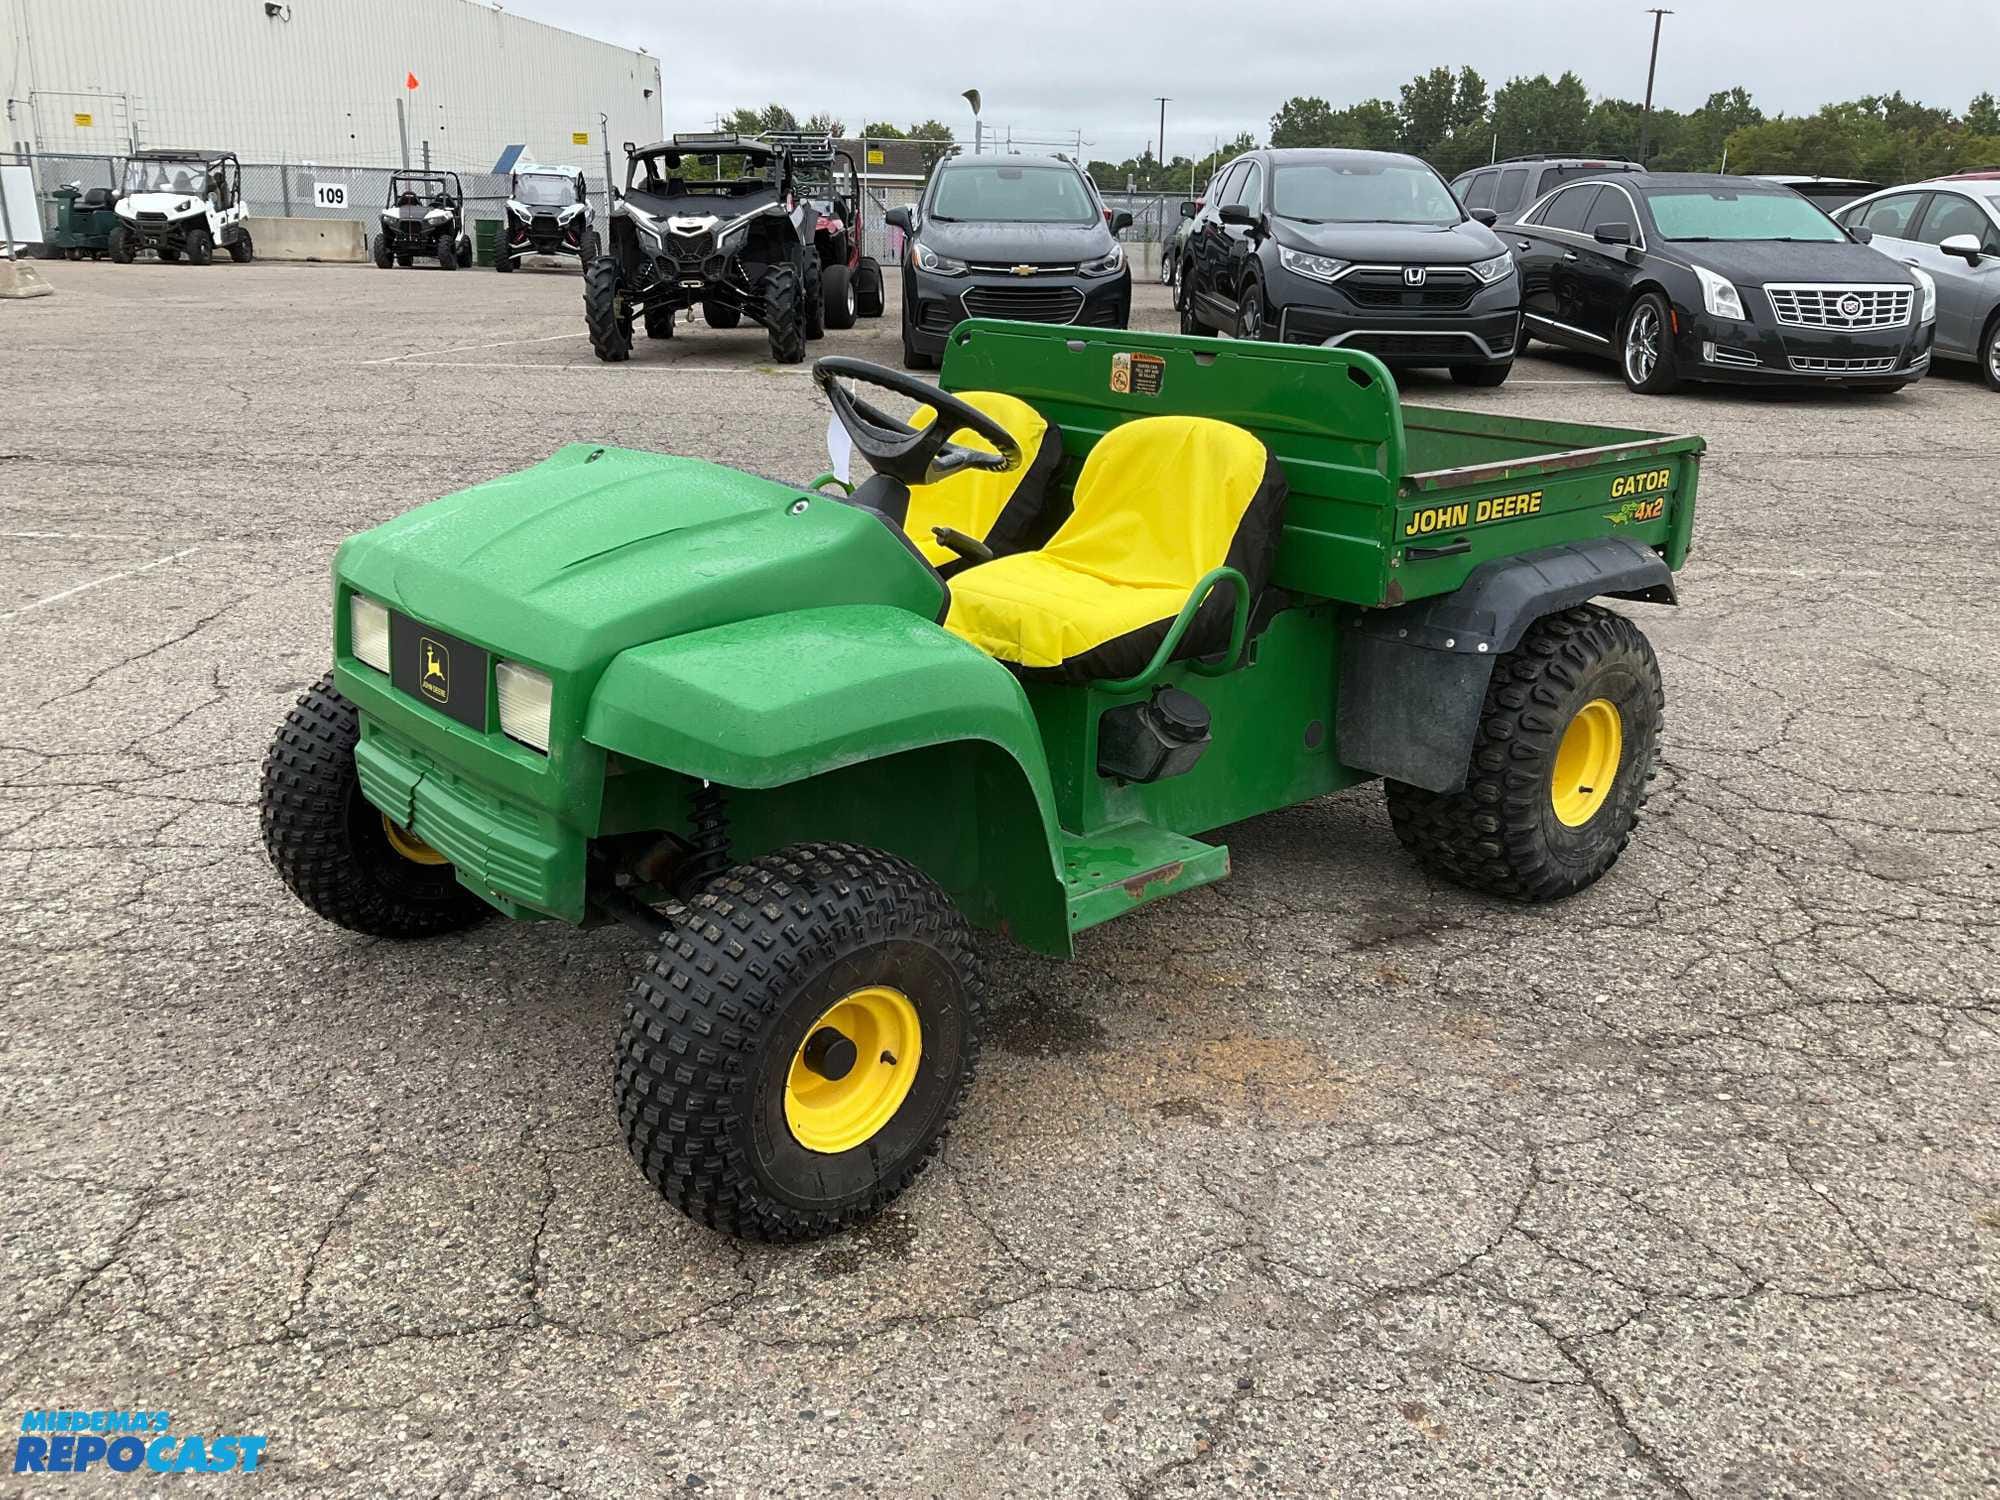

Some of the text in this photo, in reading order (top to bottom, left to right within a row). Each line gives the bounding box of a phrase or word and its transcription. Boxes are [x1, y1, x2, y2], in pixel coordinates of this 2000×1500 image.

[318, 187, 344, 204] 109
[1611, 468, 1670, 498] GATOR
[1405, 491, 1543, 536] JOHN DEERE
[1634, 497, 1665, 521] 4x2
